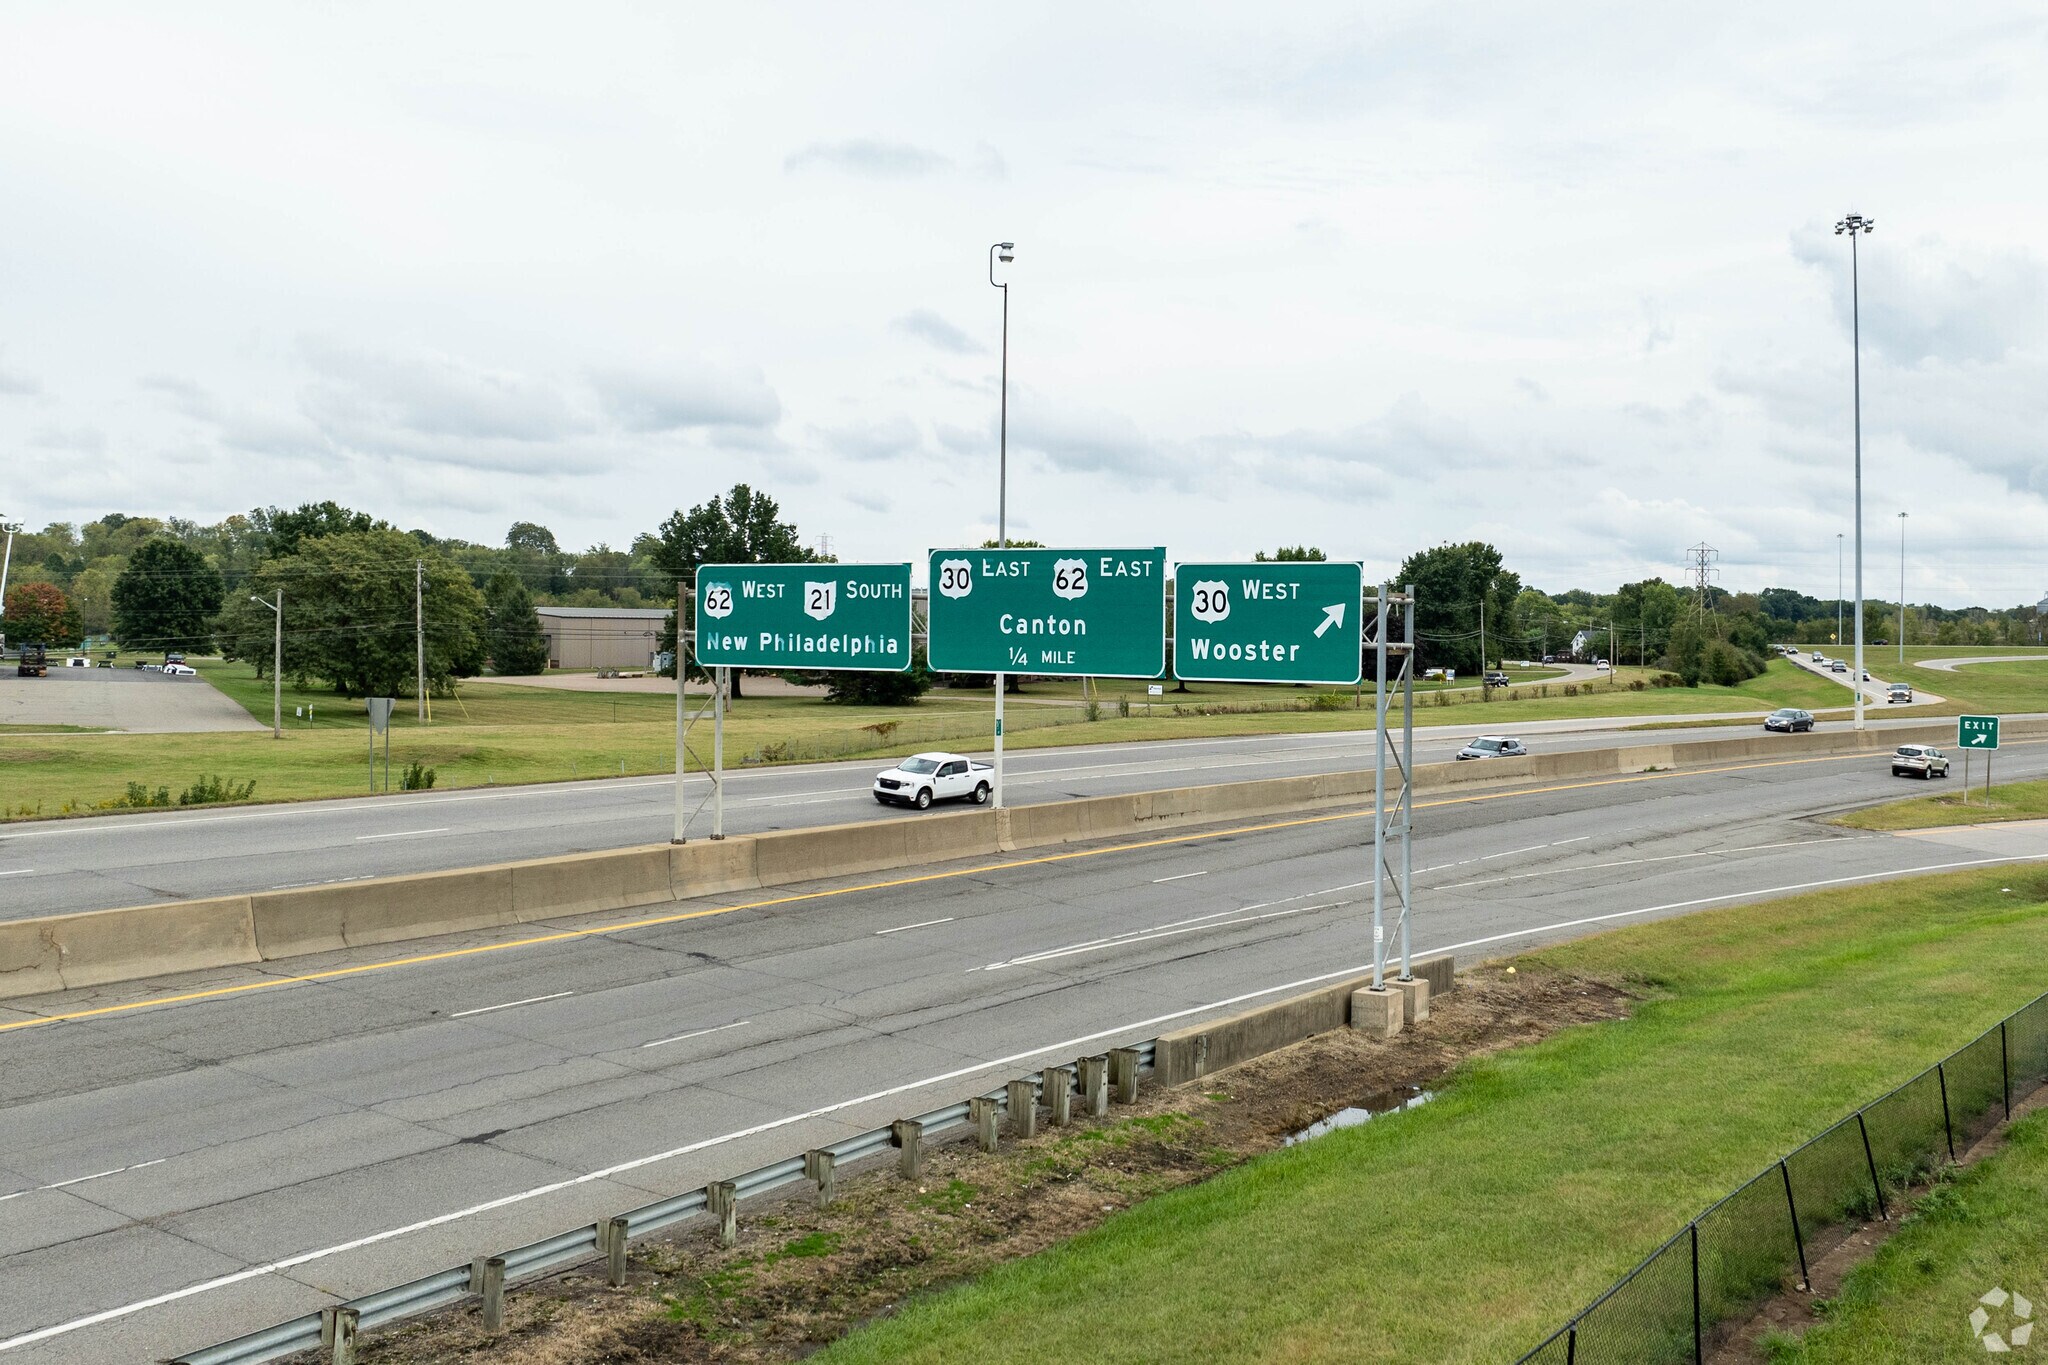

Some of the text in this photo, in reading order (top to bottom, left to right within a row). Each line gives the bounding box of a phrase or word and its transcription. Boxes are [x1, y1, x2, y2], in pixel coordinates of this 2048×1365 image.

[942, 557, 1153, 590] 30 EAST 62 EAST
[707, 579, 902, 610] 62 WEST 21 SOUTH
[1195, 579, 1301, 614] 30 WEST
[999, 613, 1086, 636] Canton
[707, 632, 898, 657] New Philadelphia
[1190, 638, 1301, 662] Wooster
[1041, 650, 1076, 664] MILE
[1964, 720, 1994, 731] EXIT
